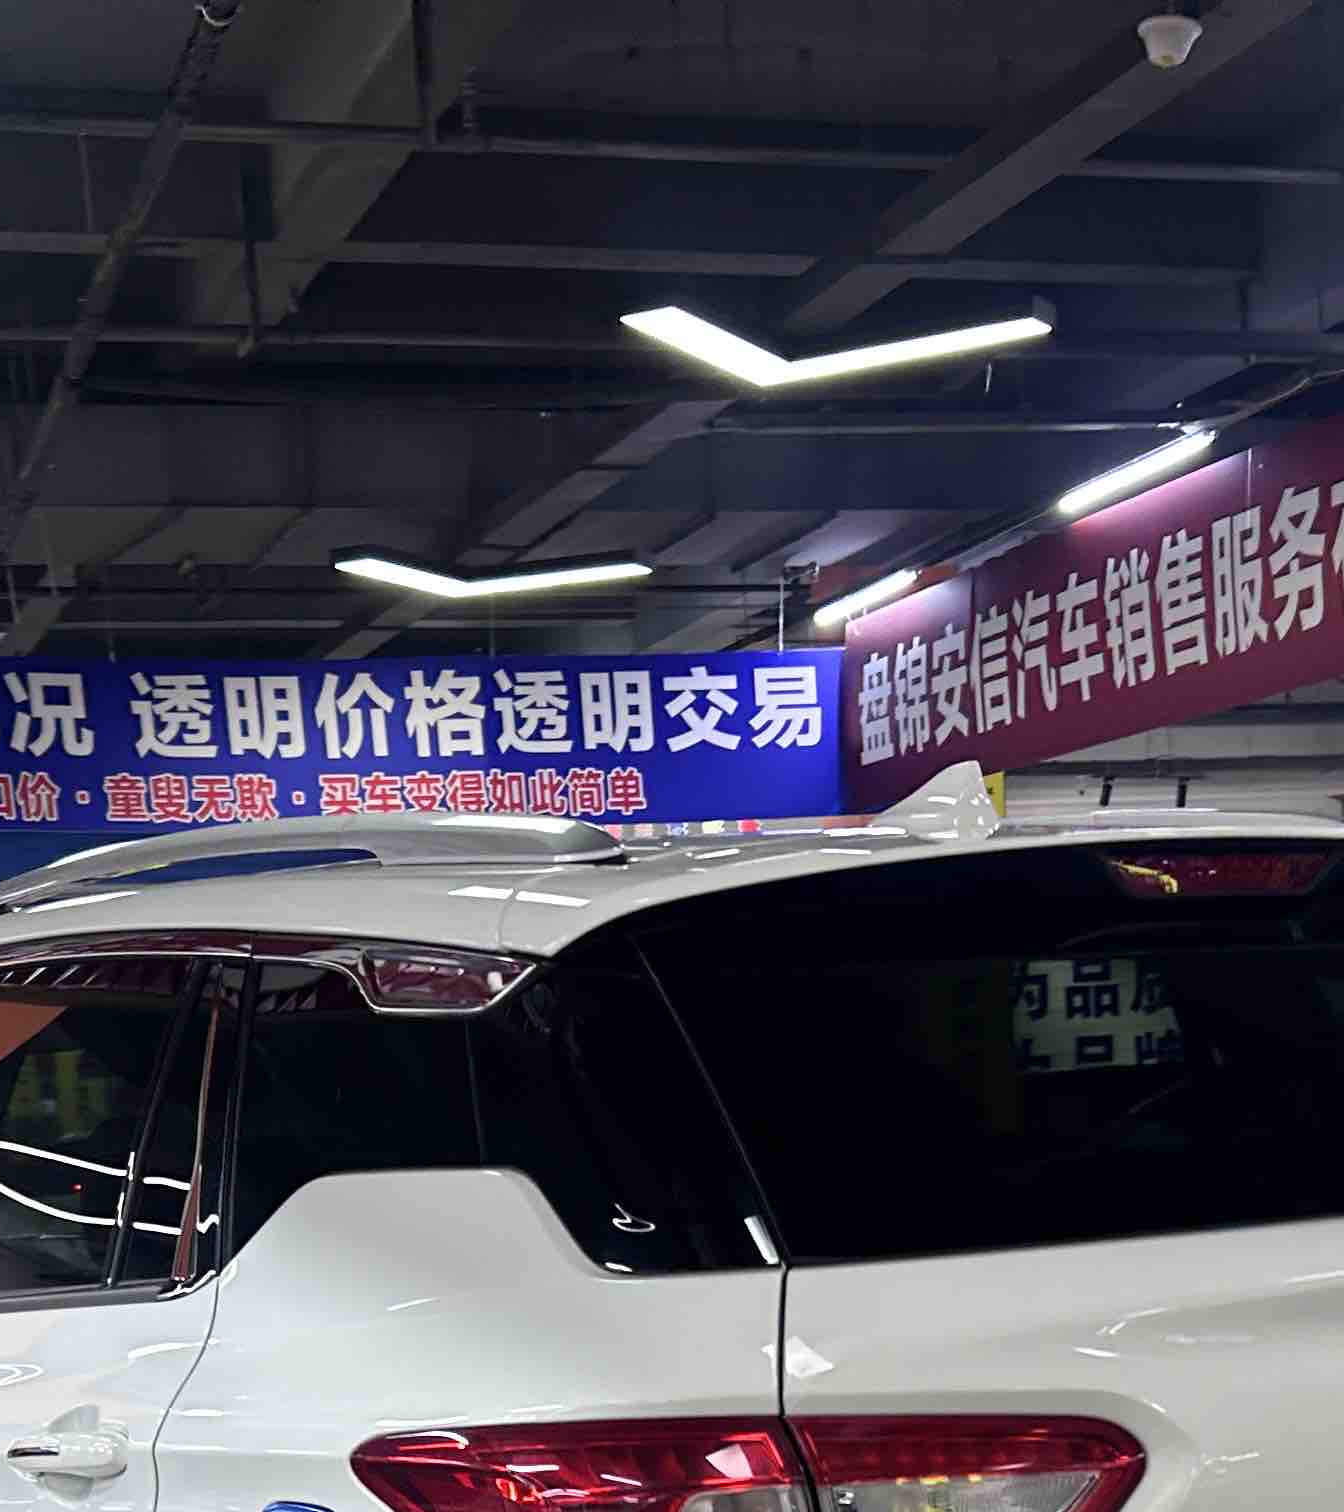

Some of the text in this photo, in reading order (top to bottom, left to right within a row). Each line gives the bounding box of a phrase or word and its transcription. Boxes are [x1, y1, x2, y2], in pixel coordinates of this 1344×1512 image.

[129, 664, 823, 761] 透明价格透明交易
